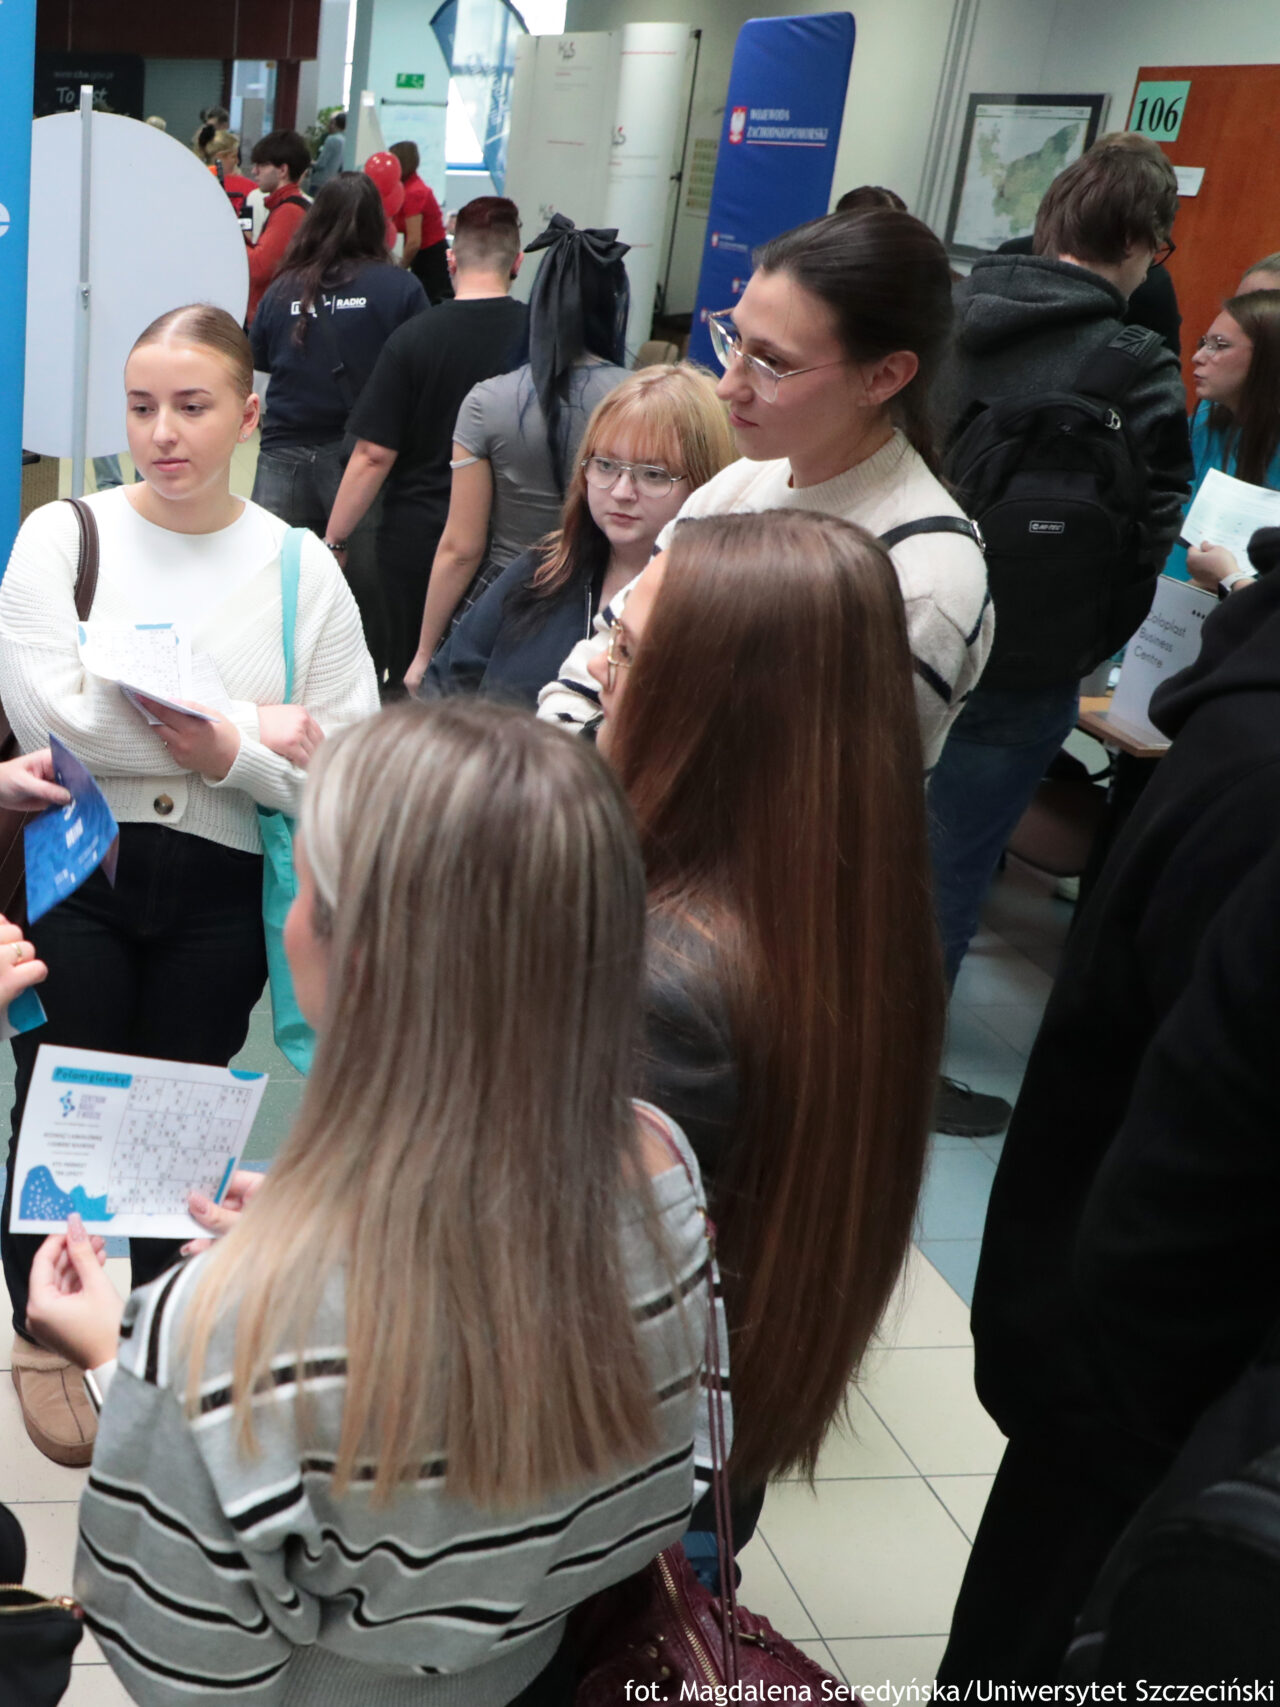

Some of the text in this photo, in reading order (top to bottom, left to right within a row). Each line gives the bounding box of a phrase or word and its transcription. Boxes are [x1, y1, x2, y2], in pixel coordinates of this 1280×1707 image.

[1134, 96, 1183, 133] 106
[336, 297, 367, 307] RADIO
[1134, 645, 1163, 669] Centre
